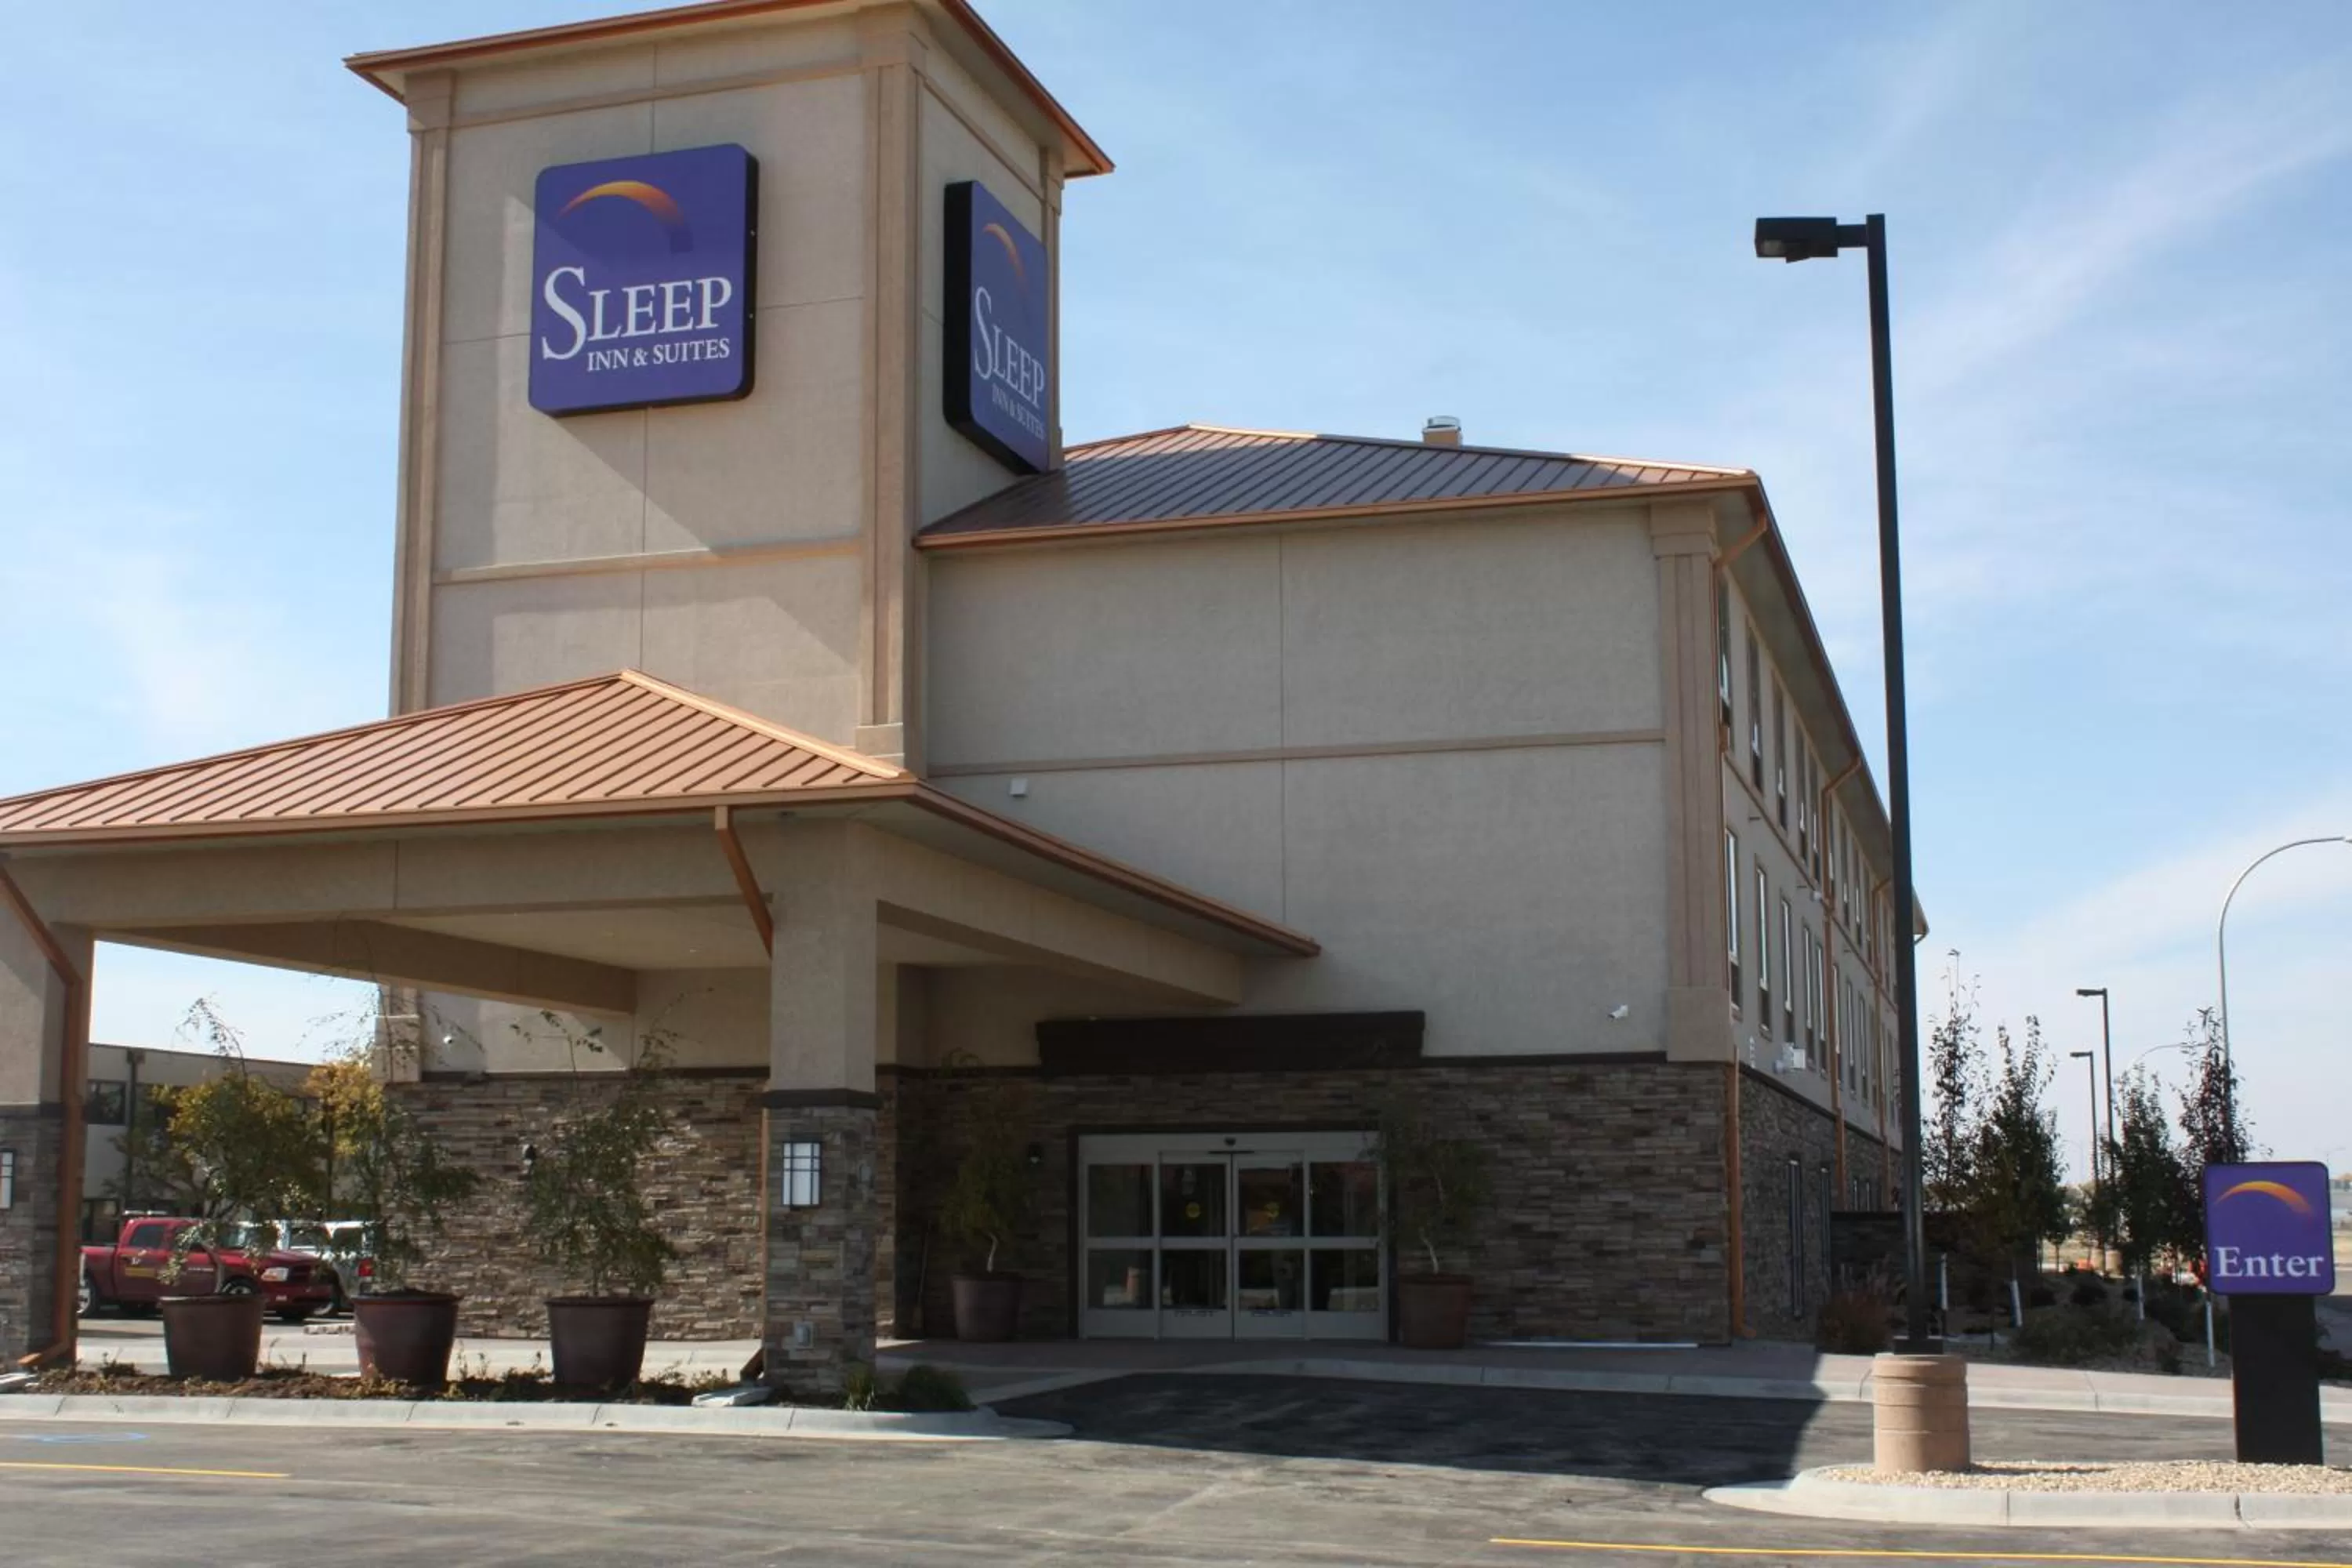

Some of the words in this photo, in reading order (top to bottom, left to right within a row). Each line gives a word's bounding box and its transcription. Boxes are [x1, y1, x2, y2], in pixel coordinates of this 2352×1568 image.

[542, 267, 732, 360] SLEEP
[587, 349, 629, 372] INN
[633, 348, 648, 366] &
[653, 338, 731, 365] SUITES
[975, 286, 1045, 408] SLEEP
[2214, 1247, 2325, 1277] Enter
